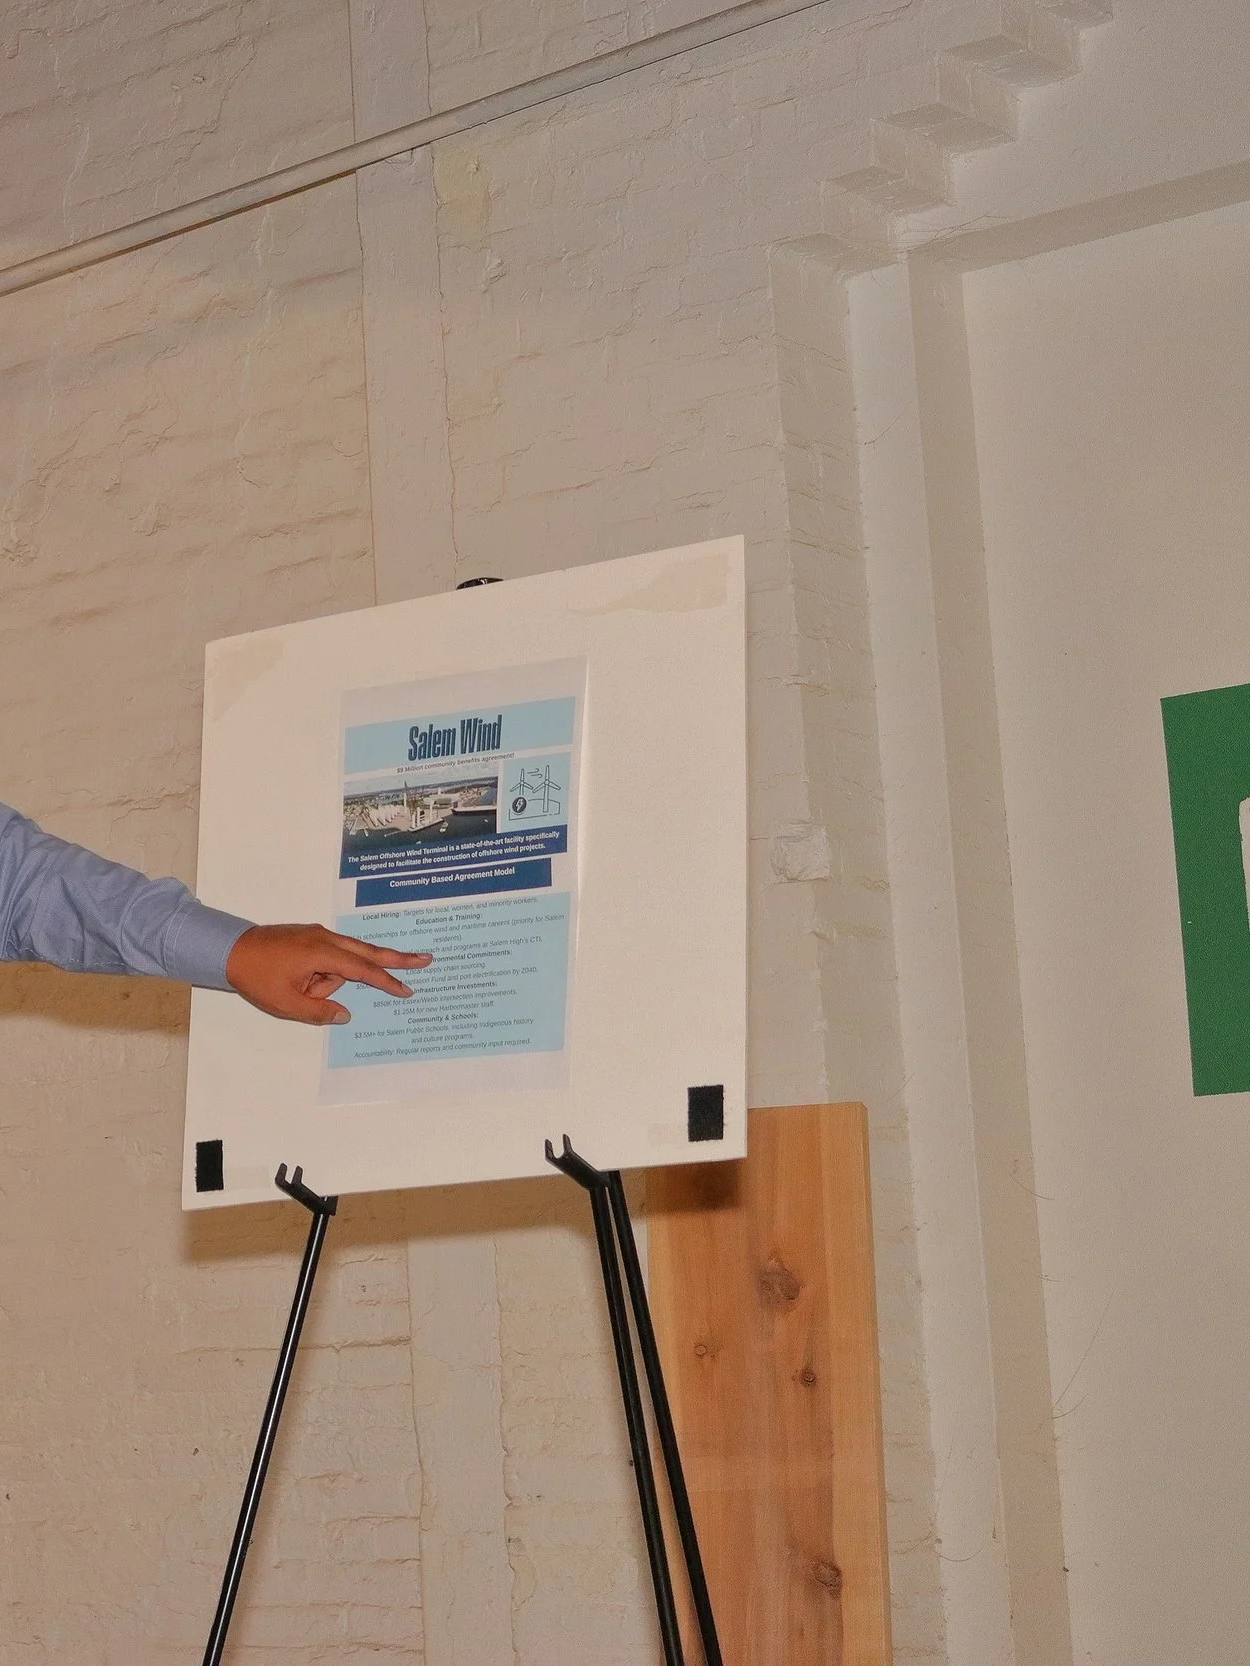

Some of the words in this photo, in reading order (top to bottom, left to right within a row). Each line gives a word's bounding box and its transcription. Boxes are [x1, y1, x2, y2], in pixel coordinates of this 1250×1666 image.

[408, 724, 456, 761] Salem
[460, 715, 502, 754] Wind
[425, 761, 456, 769] community
[457, 757, 480, 765] benefits
[380, 851, 405, 859] Offshore
[423, 846, 447, 854] Terminal
[461, 838, 503, 849] state-of-the-art
[505, 836, 524, 844] facility
[526, 831, 559, 841] specifically
[360, 862, 387, 870] designed
[396, 858, 421, 866] facilitate
[433, 853, 470, 862] construction
[478, 849, 502, 857] offshore
[520, 843, 545, 852] projects.
[390, 878, 430, 887] Community
[431, 874, 453, 883] Based
[454, 872, 493, 881] Agreement
[494, 867, 515, 876] Model
[416, 916, 447, 925] Education
[363, 932, 399, 940] scholarships
[450, 923, 460, 931] and
[511, 917, 533, 925] (priority
[454, 942, 480, 951] programs
[510, 937, 528, 945] High's
[432, 953, 465, 962] ironmental
[467, 950, 512, 959] Commitments:
[423, 967, 442, 975] supply
[472, 969, 511, 978] electrification
[414, 984, 455, 994] Infrastructure
[457, 981, 497, 990] Investments:
[374, 1000, 391, 1008] $850K
[402, 995, 438, 1006] Essex/Webb
[440, 994, 473, 1003] intersection
[440, 1001, 479, 1011] Harbormaster
[407, 1015, 443, 1024] Community
[451, 1012, 478, 1020] Schools:
[406, 1026, 424, 1034] Public
[479, 1019, 511, 1028] Indigenous
[396, 1047, 419, 1056] Regular
[420, 1045, 440, 1053] reports
[455, 1041, 487, 1049] community
[488, 1040, 503, 1048] input
